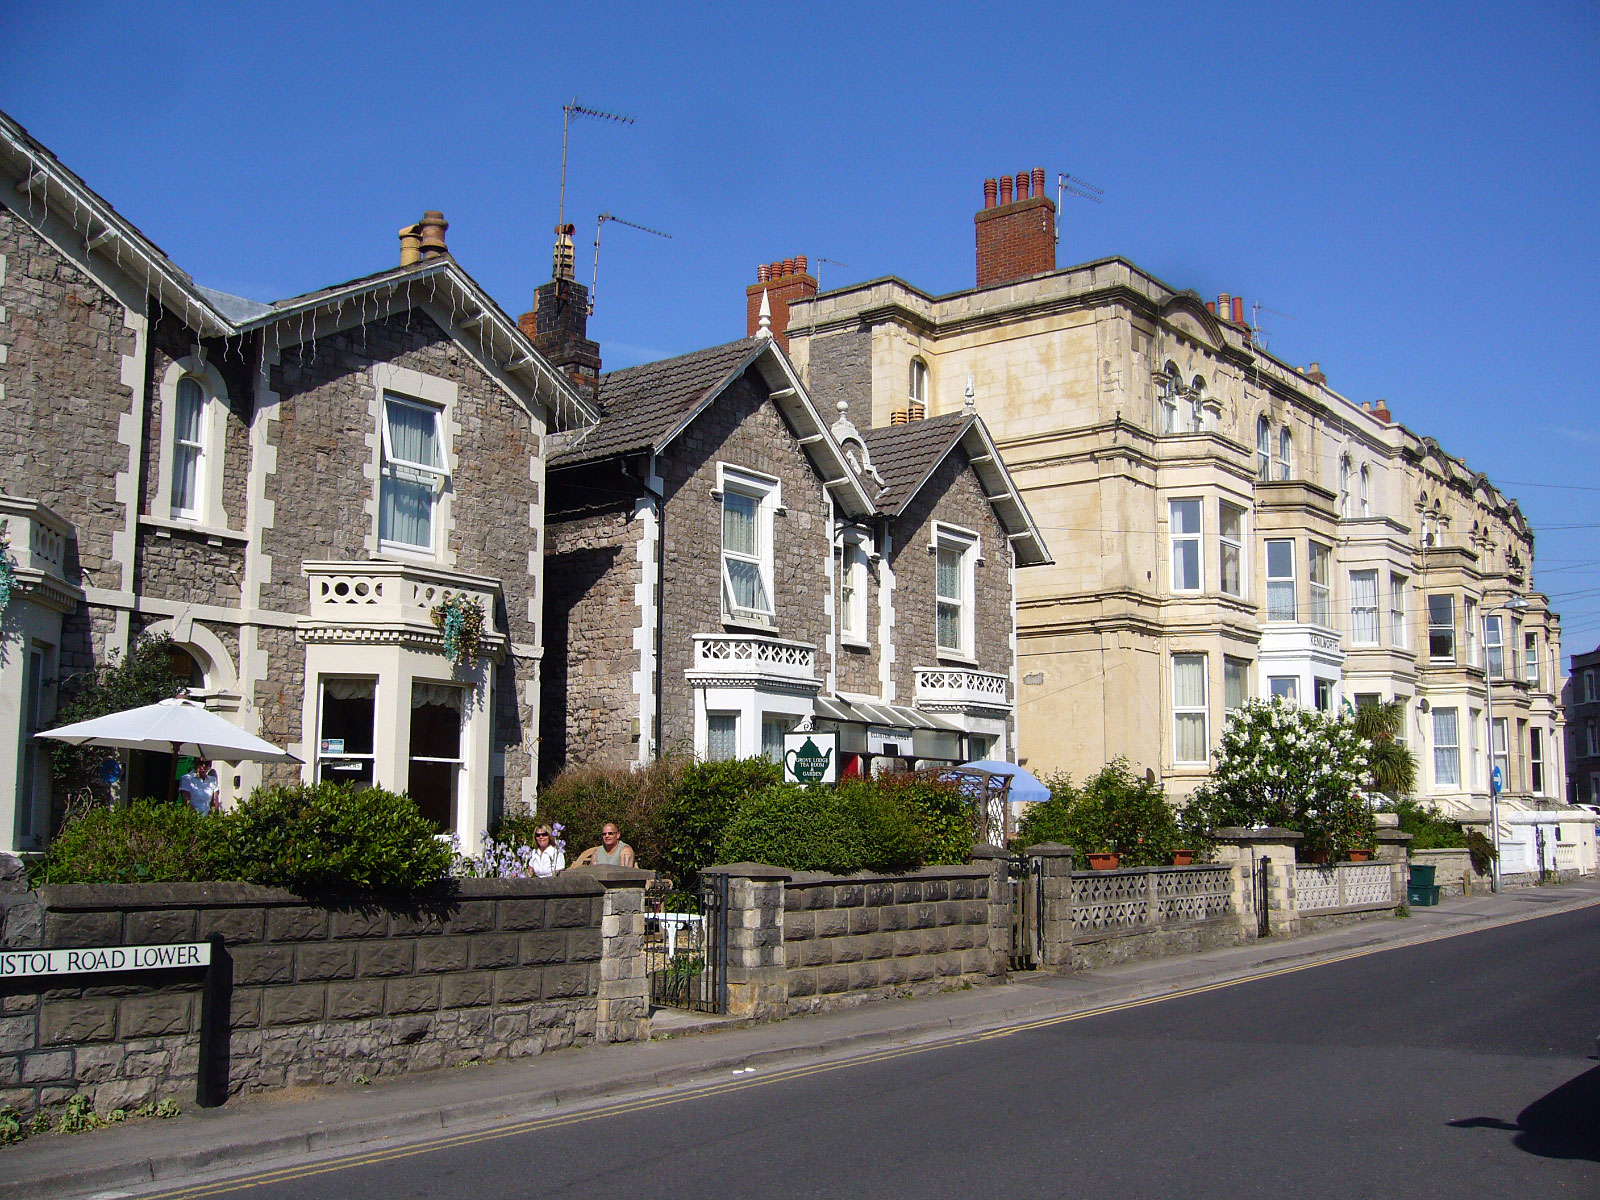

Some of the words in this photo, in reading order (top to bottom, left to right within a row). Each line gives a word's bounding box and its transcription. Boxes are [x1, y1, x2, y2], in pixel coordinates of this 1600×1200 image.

[1311, 635, 1338, 652] KENILWORTH
[68, 950, 126, 971] ROAD
[134, 946, 201, 967] LOWER
